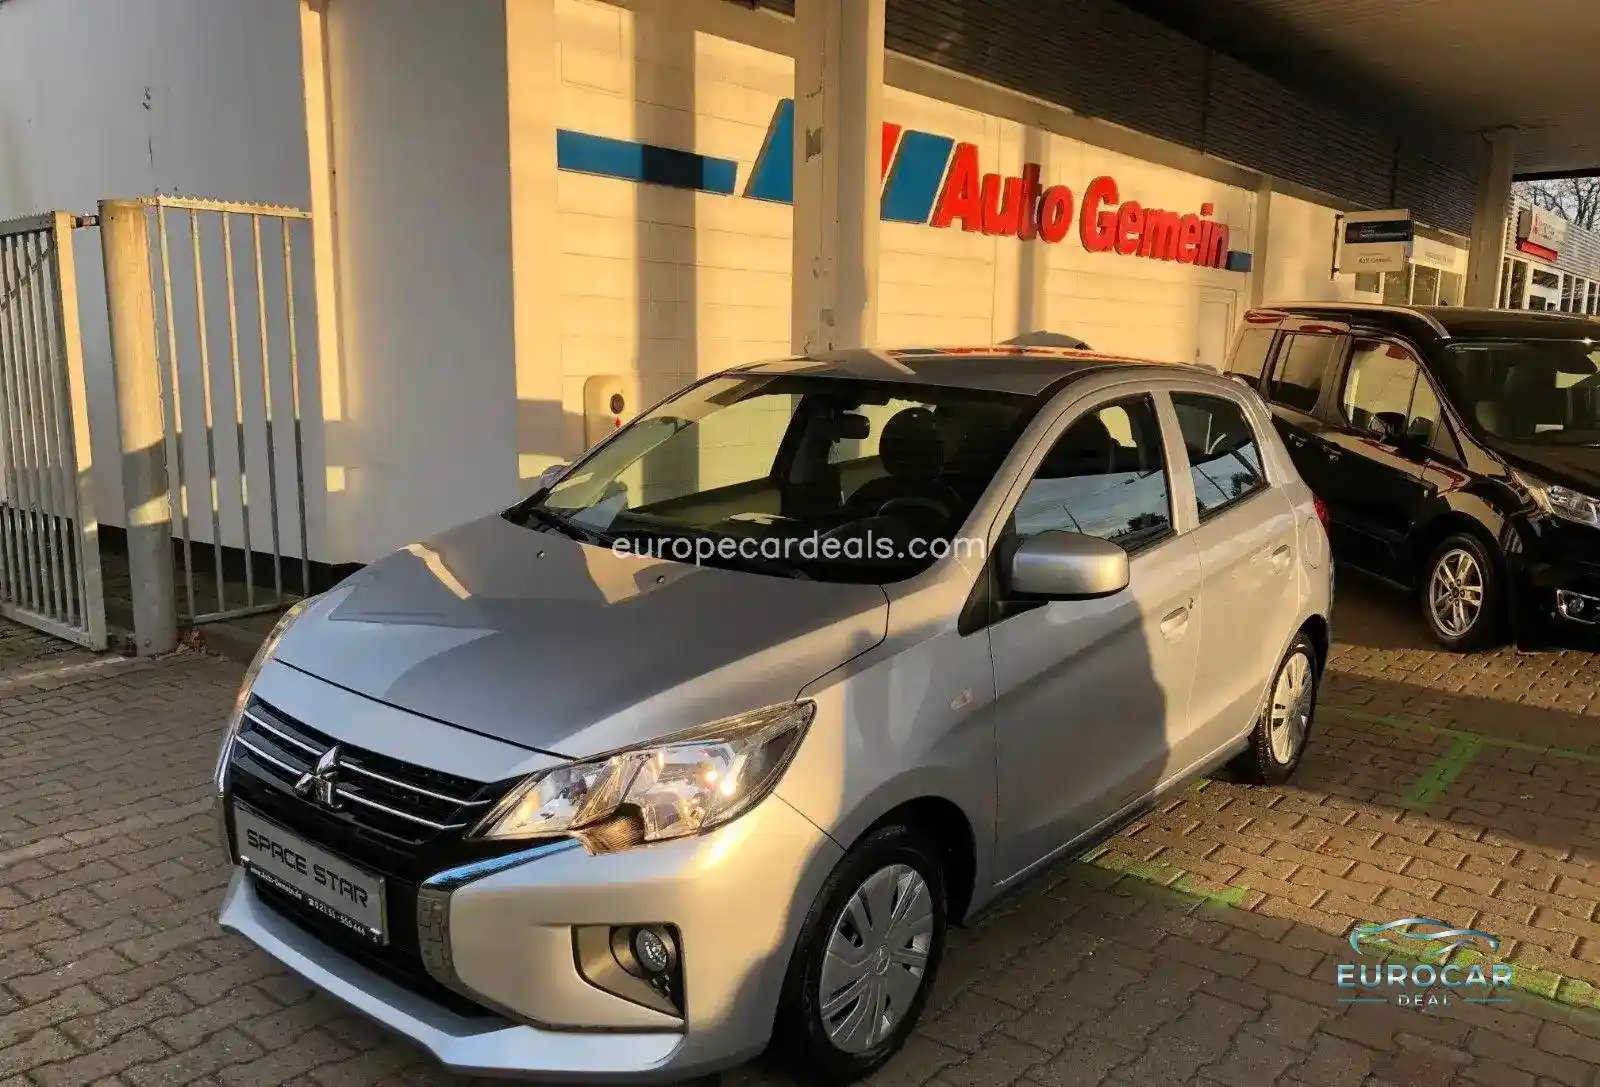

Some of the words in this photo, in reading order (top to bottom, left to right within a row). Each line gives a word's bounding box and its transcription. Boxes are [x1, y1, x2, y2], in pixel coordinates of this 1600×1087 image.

[929, 142, 1074, 244] Auto
[1079, 175, 1230, 270] Gemein
[246, 828, 308, 876] SPACE
[313, 863, 369, 909] STAR
